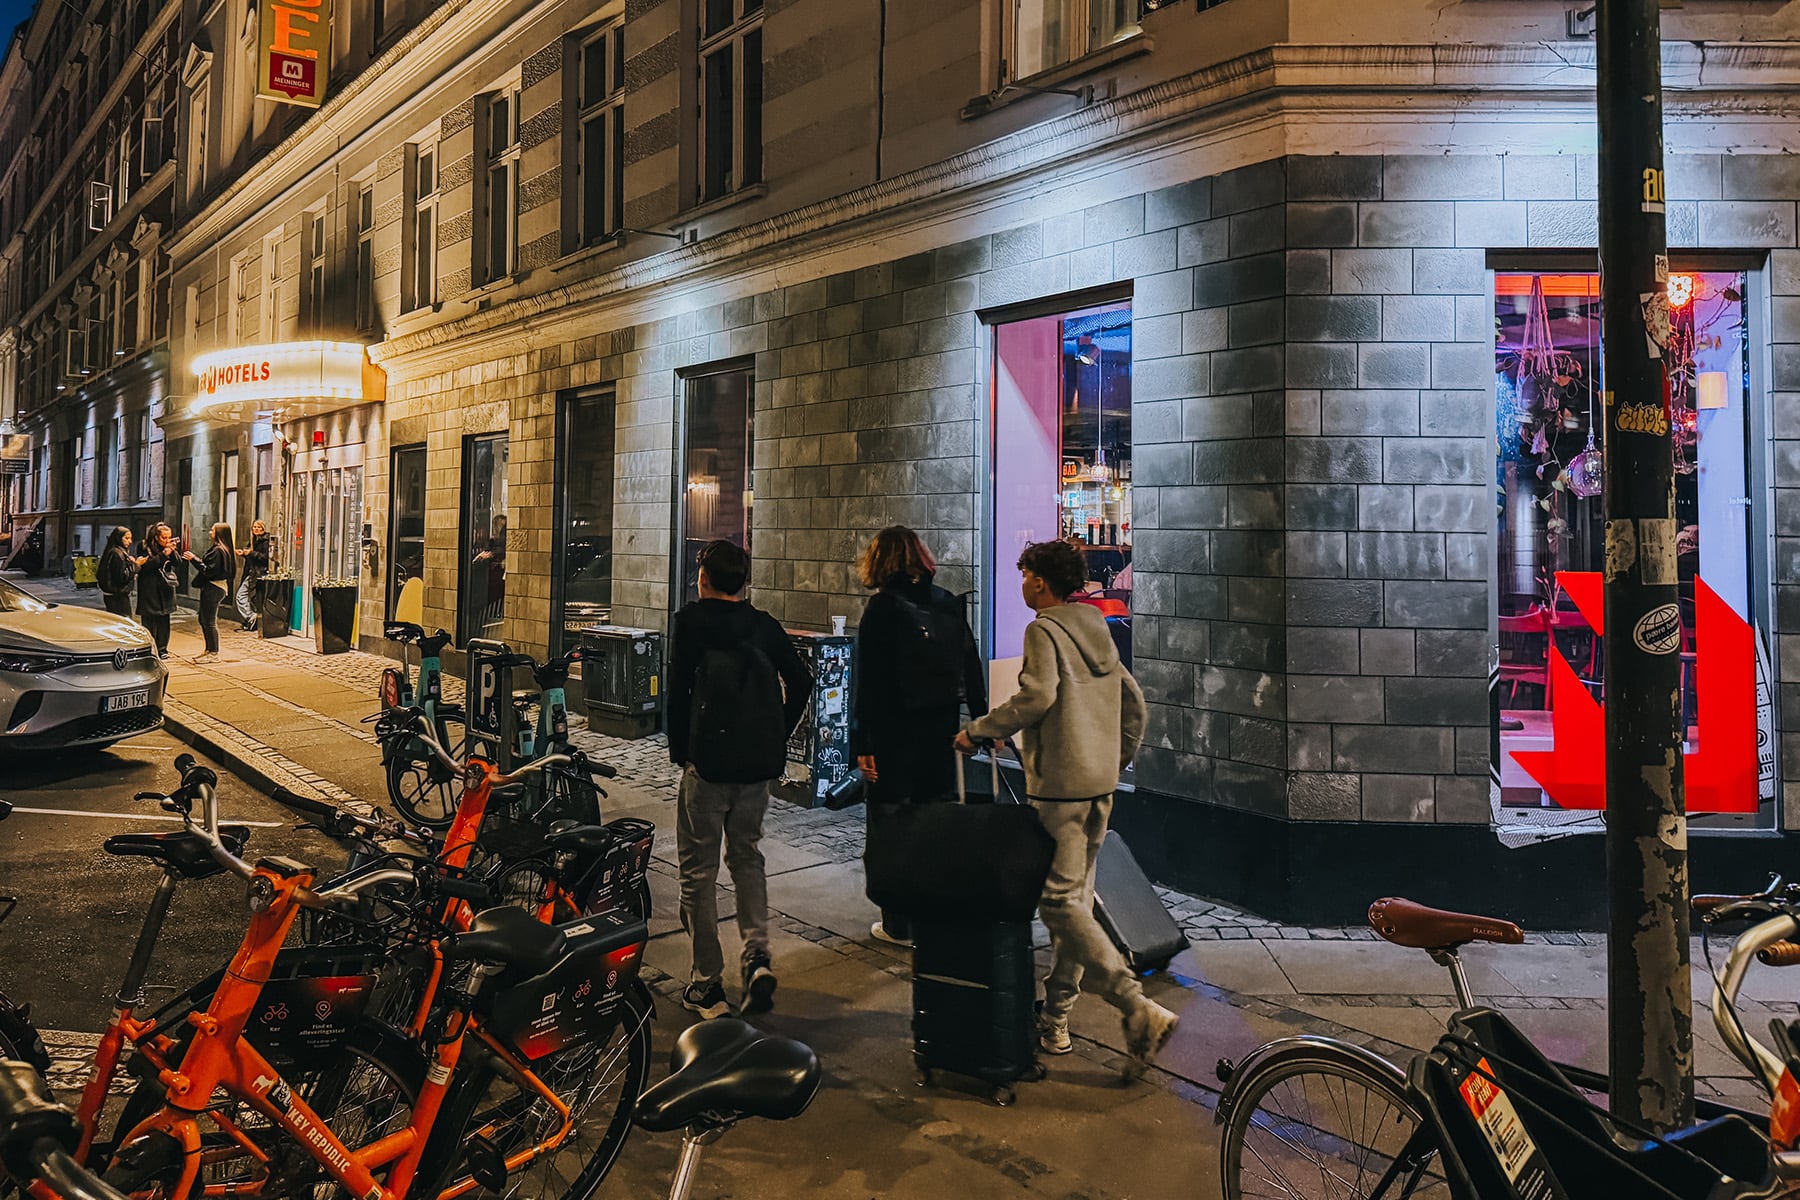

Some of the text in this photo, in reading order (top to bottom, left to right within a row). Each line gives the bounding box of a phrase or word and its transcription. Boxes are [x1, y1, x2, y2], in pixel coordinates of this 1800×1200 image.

[274, 76, 310, 88] MEININGER
[218, 361, 270, 385] HOTELS
[1063, 464, 1077, 475] BAR
[480, 663, 496, 716] P
[111, 693, 147, 710] JAB 19C
[1473, 927, 1504, 936] RALEIGH
[306, 1127, 351, 1173] REPUBLIC
